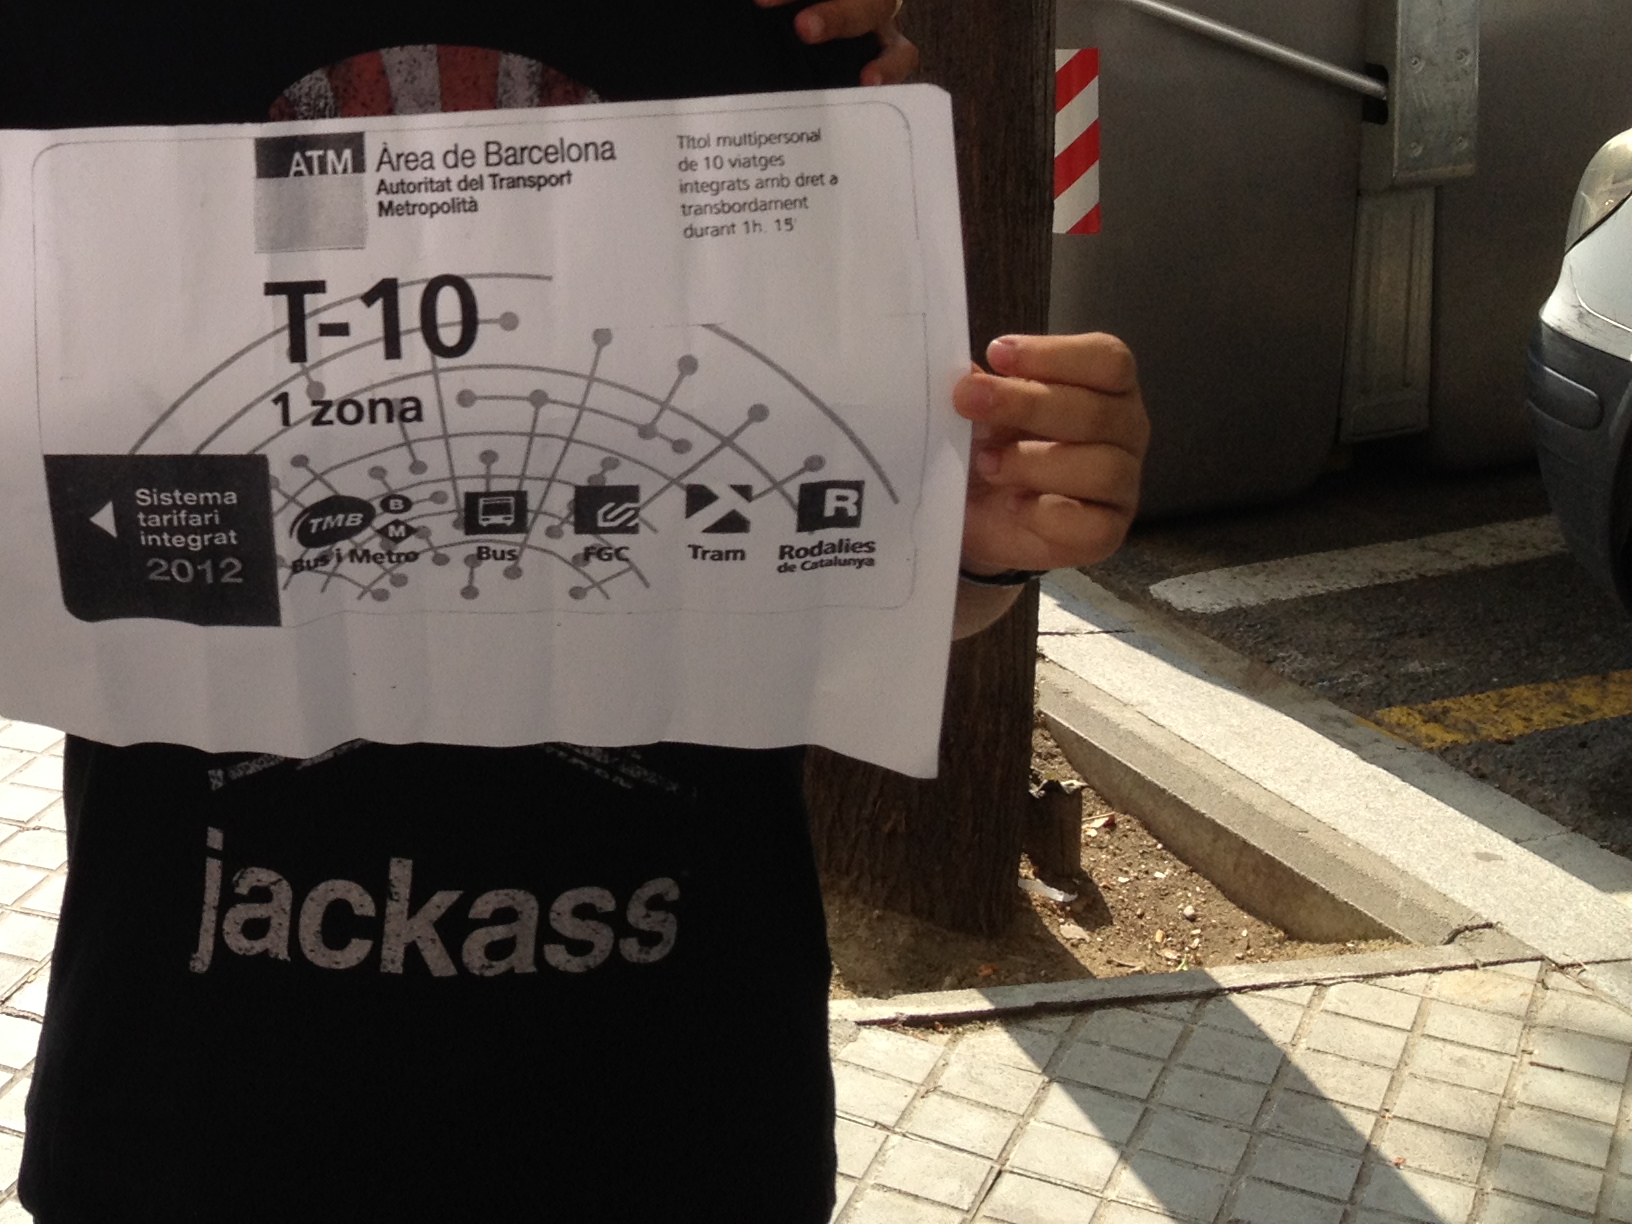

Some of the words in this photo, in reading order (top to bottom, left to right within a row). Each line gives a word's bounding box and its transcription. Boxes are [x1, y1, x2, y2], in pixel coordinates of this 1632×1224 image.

[716, 128, 822, 149] multipersonal
[288, 147, 353, 176] ATM
[376, 142, 435, 173] Àrea
[443, 143, 476, 169] de
[484, 137, 617, 167] Barcelona
[678, 157, 699, 172] de
[704, 155, 724, 170] 10
[728, 153, 786, 171] viatges
[376, 177, 452, 196] Autoritat
[457, 173, 485, 192] del
[490, 170, 573, 191] Transport
[679, 177, 750, 196] integrats
[754, 173, 791, 189] amb
[795, 172, 826, 188] dret
[829, 174, 839, 186] a
[378, 197, 480, 218] Metropolità
[680, 196, 809, 216] transbordament
[683, 222, 736, 239] durant
[264, 274, 478, 363] T-10
[272, 392, 290, 427] 1
[311, 396, 423, 426] zona
[135, 488, 238, 506] Sistema
[389, 498, 404, 510] B
[823, 488, 860, 518] R
[137, 510, 220, 527] tarifari
[309, 513, 364, 533] TMB
[140, 529, 238, 551] integrat
[388, 525, 406, 537] M
[476, 546, 519, 562] Bus
[584, 546, 630, 563] FGC
[687, 545, 746, 562] Tram
[779, 538, 876, 561] Rodalies
[146, 557, 243, 584] 2012
[291, 551, 330, 574] Bus
[335, 548, 343, 563] i
[349, 548, 419, 564] Metro
[777, 559, 798, 573] de
[801, 555, 875, 572] Catalunya
[189, 826, 680, 977] jackass
